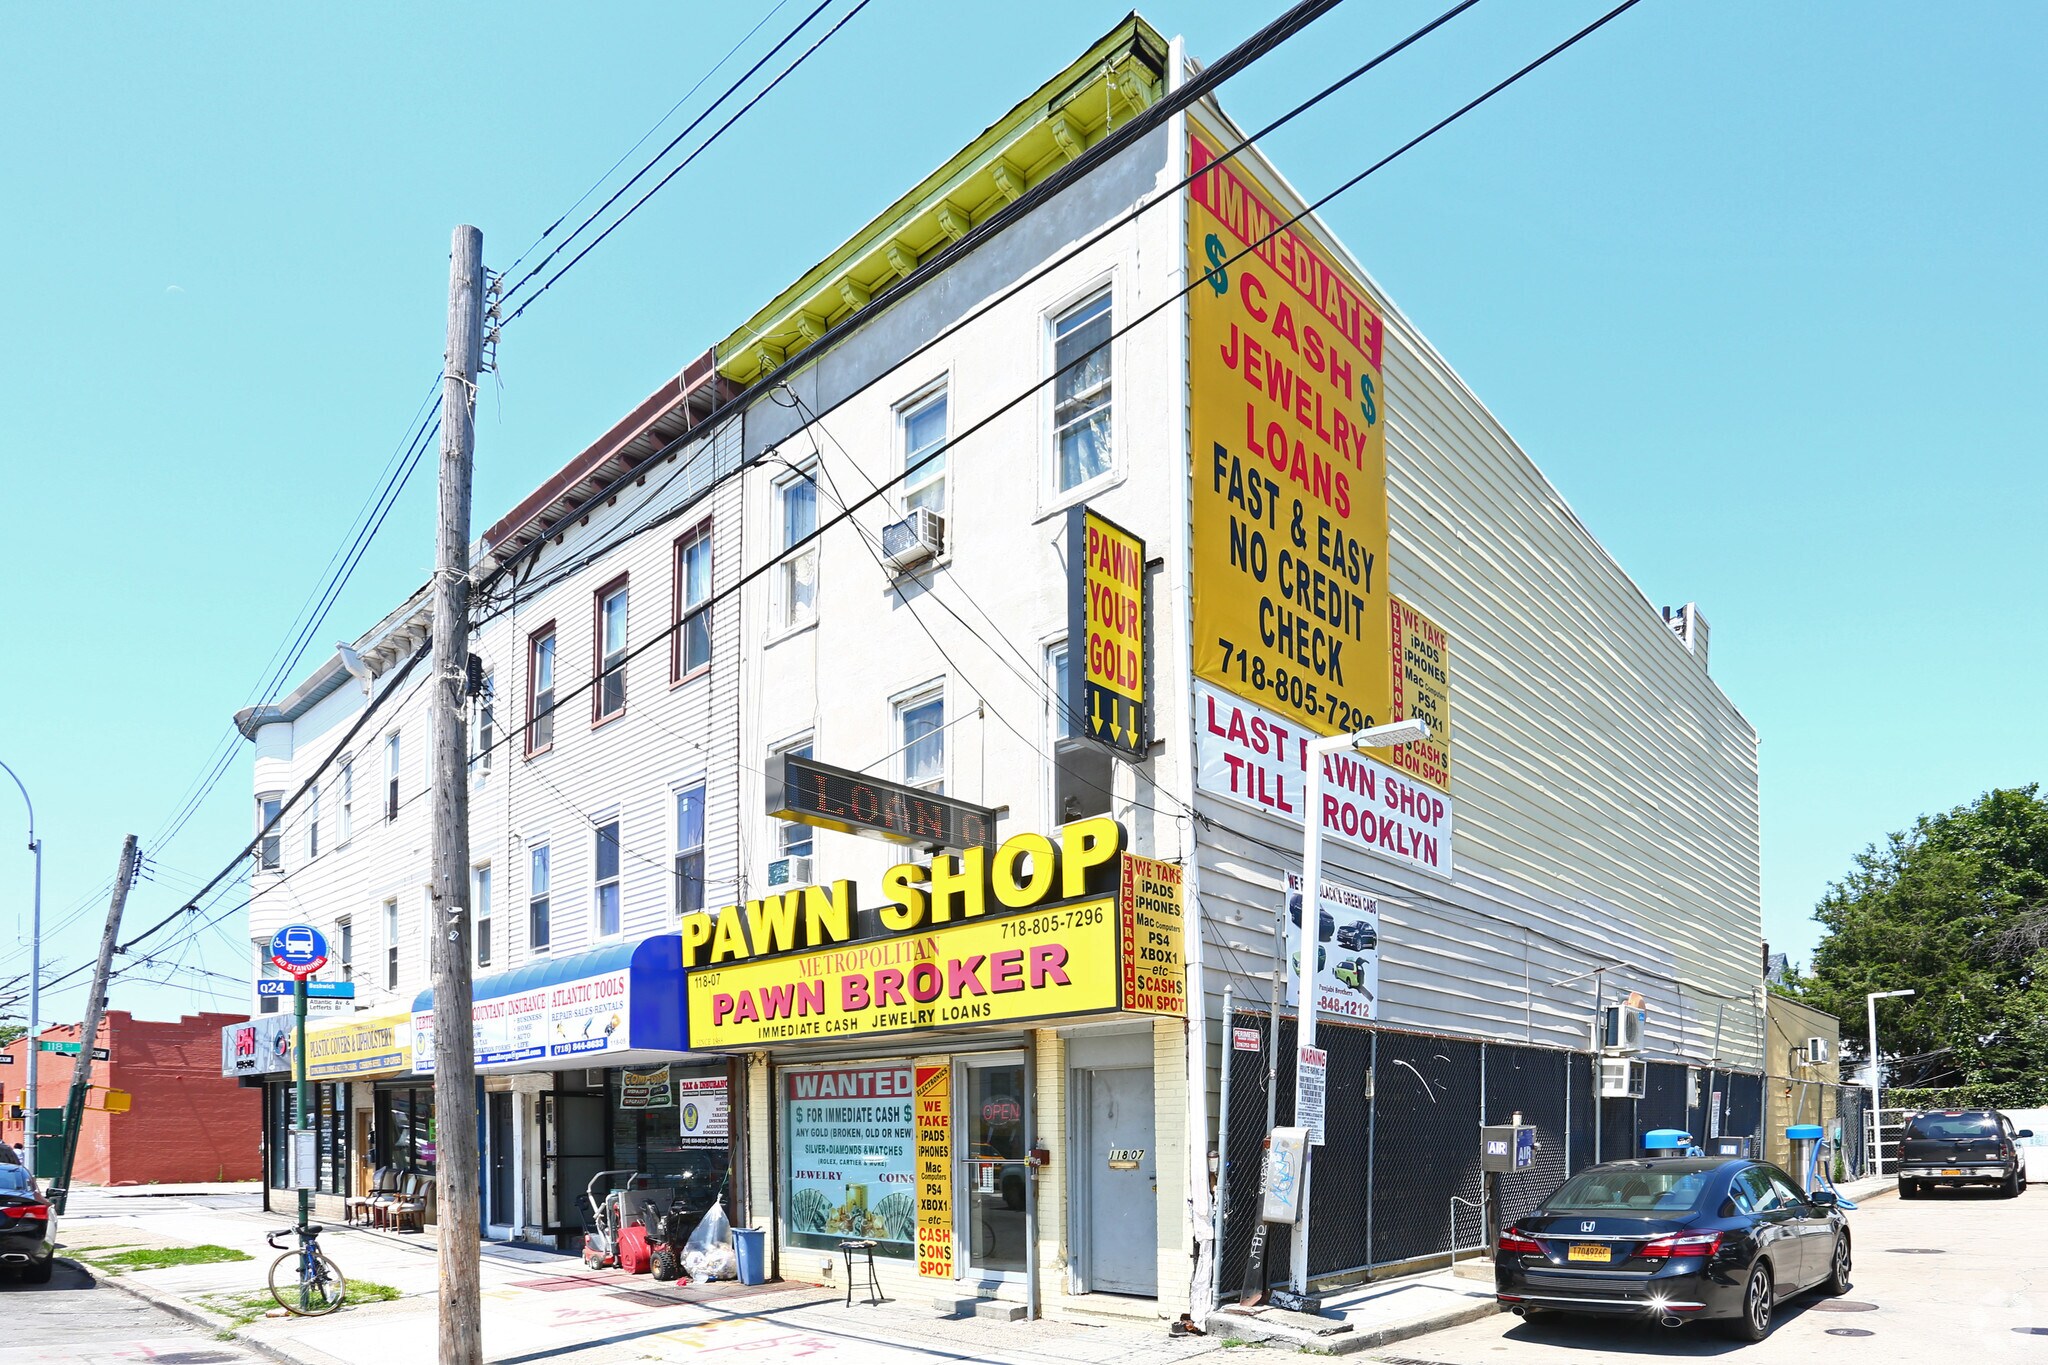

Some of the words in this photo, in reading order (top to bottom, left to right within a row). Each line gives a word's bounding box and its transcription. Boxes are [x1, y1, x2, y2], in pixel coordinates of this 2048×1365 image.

[1206, 154, 1373, 359] IMMEDIATE
[1203, 233, 1229, 298] $
[1240, 272, 1352, 402] CASH
[1360, 373, 1376, 428] $
[1220, 322, 1367, 471] JEWELRY
[1247, 402, 1350, 519] LOANS
[1213, 441, 1280, 530] FAST
[1291, 499, 1307, 550] &
[1318, 515, 1375, 594] EASY
[1089, 527, 1139, 591] PAWN
[1230, 515, 1267, 582] NO
[1278, 549, 1364, 642] CREDIT
[1089, 579, 1139, 641] YOUR
[1402, 607, 1419, 633] WE
[1422, 620, 1446, 652] TAKE
[1259, 596, 1344, 687] CHECK
[1411, 634, 1439, 663] iPADS
[1090, 633, 1137, 691] GOLD
[1404, 647, 1446, 684] iPHONES
[1391, 602, 1403, 764] ELECTRONS
[1405, 666, 1424, 687] Mac
[1424, 683, 1446, 702] Computers
[1418, 691, 1437, 712] PS4
[1411, 704, 1443, 733] XBOX1
[1208, 695, 1288, 762] LAST
[1384, 776, 1444, 827] SHOP
[1405, 754, 1420, 774] ON
[1423, 763, 1448, 787] SPOT
[1223, 752, 1293, 814] TILL
[1303, 786, 1438, 867] ROOKLYN
[1135, 859, 1151, 877] WE
[1156, 864, 1181, 884] TAKE
[682, 879, 855, 967] PAWN
[879, 817, 1122, 932] SHOP
[1142, 880, 1174, 899] iPADS
[1288, 872, 1299, 890] WE
[1343, 892, 1362, 909] GREEN
[1363, 897, 1377, 914] CABS
[1136, 895, 1180, 916] iPHONES
[1001, 907, 1103, 939] 718-805-7296
[1123, 859, 1134, 1006] ELECTRONICS
[1136, 913, 1154, 927] Mac
[1155, 921, 1180, 933] Computers
[1149, 932, 1169, 946] PS4
[276, 957, 287, 967] NO
[287, 958, 323, 971] STANDING
[799, 936, 940, 978] METROPOLITAN
[1140, 947, 1177, 964] XBOX1
[695, 973, 720, 988] 118-07
[1152, 965, 1168, 976] etc
[260, 982, 285, 993] Q24
[552, 984, 591, 1007] ATLANTIC
[595, 977, 624, 999] TOOLS
[713, 979, 825, 1026] PAWN
[841, 944, 1072, 1012] BROKER
[472, 1002, 504, 1021] COUNTANT
[508, 993, 545, 1015] INSURANCE
[1137, 994, 1153, 1009] ON
[1157, 996, 1184, 1011] SPOT
[517, 1014, 542, 1023] BUSINESS
[758, 1021, 820, 1039] IMMEDIATE
[826, 1018, 858, 1032] CASH
[872, 1008, 935, 1028] JEWELRY
[942, 1003, 991, 1021] LOANS
[310, 1038, 330, 1058] PLASTIC
[331, 1036, 350, 1055] COVERS
[357, 1028, 392, 1051] UPHOLSTERY
[517, 1032, 531, 1040] AUTO
[47, 1042, 63, 1051] 118
[1301, 1048, 1326, 1067] WARNING
[682, 1082, 693, 1090] TAX
[700, 1080, 728, 1089] INSURANC
[795, 1070, 912, 1098] WANTED
[917, 1067, 948, 1097] ELECTRONICS
[796, 1107, 803, 1124] $
[807, 1107, 823, 1122] FOR
[825, 1107, 872, 1122] IMMEDIATE
[876, 1107, 900, 1122] CASH
[924, 1101, 941, 1112] WE
[982, 1103, 1020, 1121] OPEN
[918, 1116, 948, 1127] TAKE
[796, 1128, 809, 1137] ANY
[811, 1128, 828, 1138] GOLD
[830, 1128, 863, 1140] (BROKEN,
[866, 1128, 879, 1138] OLD
[882, 1128, 892, 1138] OR
[921, 1130, 945, 1141] iPADS
[919, 1145, 948, 1157] iPHONES
[1488, 1141, 1507, 1155] AIR
[1518, 1146, 1531, 1160] AIR
[1721, 1145, 1737, 1155] AIR
[795, 1170, 842, 1181] JEWELRY
[921, 1173, 946, 1181] Computers
[925, 1162, 942, 1173] Mac
[879, 1173, 914, 1183] COINS
[926, 1184, 942, 1195] PS4
[921, 1200, 948, 1211] XBOX1
[928, 1216, 941, 1225] etc
[920, 1227, 950, 1243] CASH
[920, 1261, 951, 1277] SPOT
